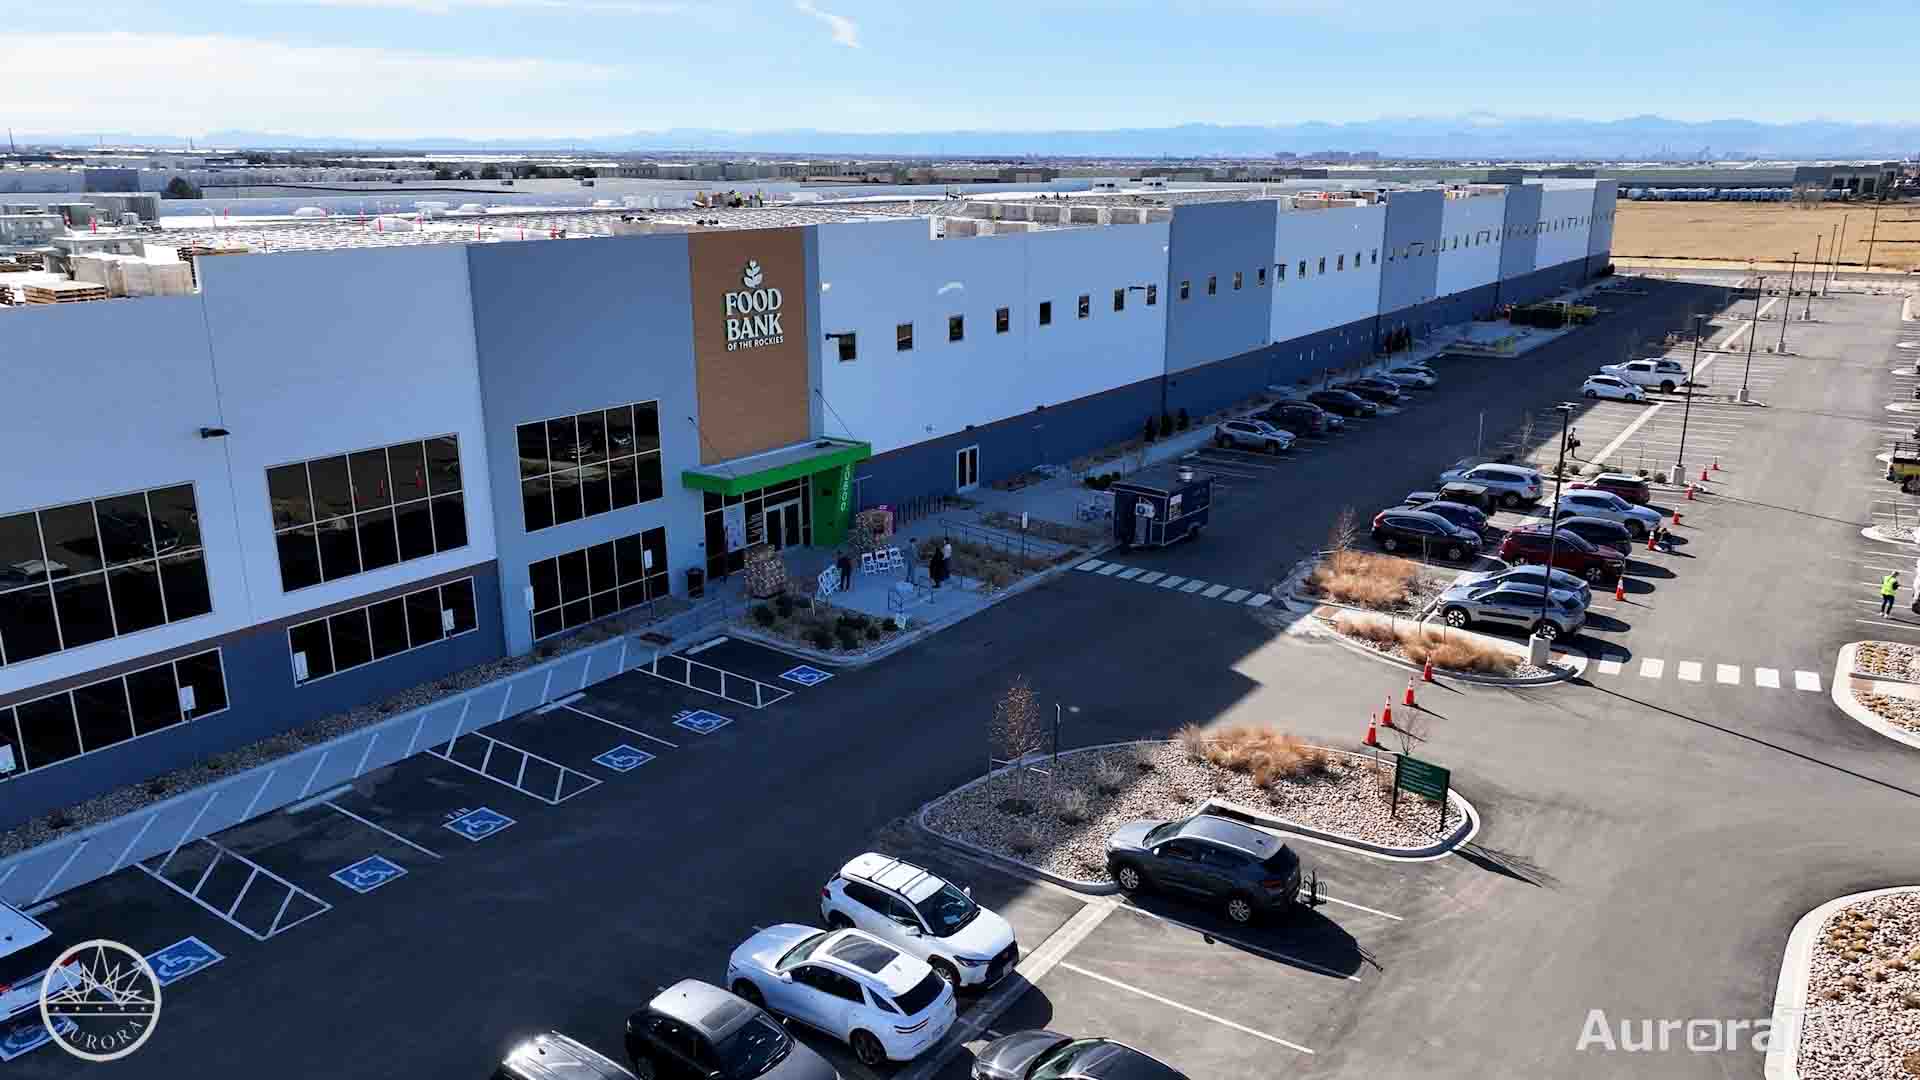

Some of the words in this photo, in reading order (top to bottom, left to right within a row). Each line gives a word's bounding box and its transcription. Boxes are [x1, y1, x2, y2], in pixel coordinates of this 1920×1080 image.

[725, 288, 782, 316] FOOD
[727, 312, 783, 342] BANK
[727, 342, 737, 352] OF
[739, 340, 753, 351] THE
[754, 336, 784, 348] ROCKIES
